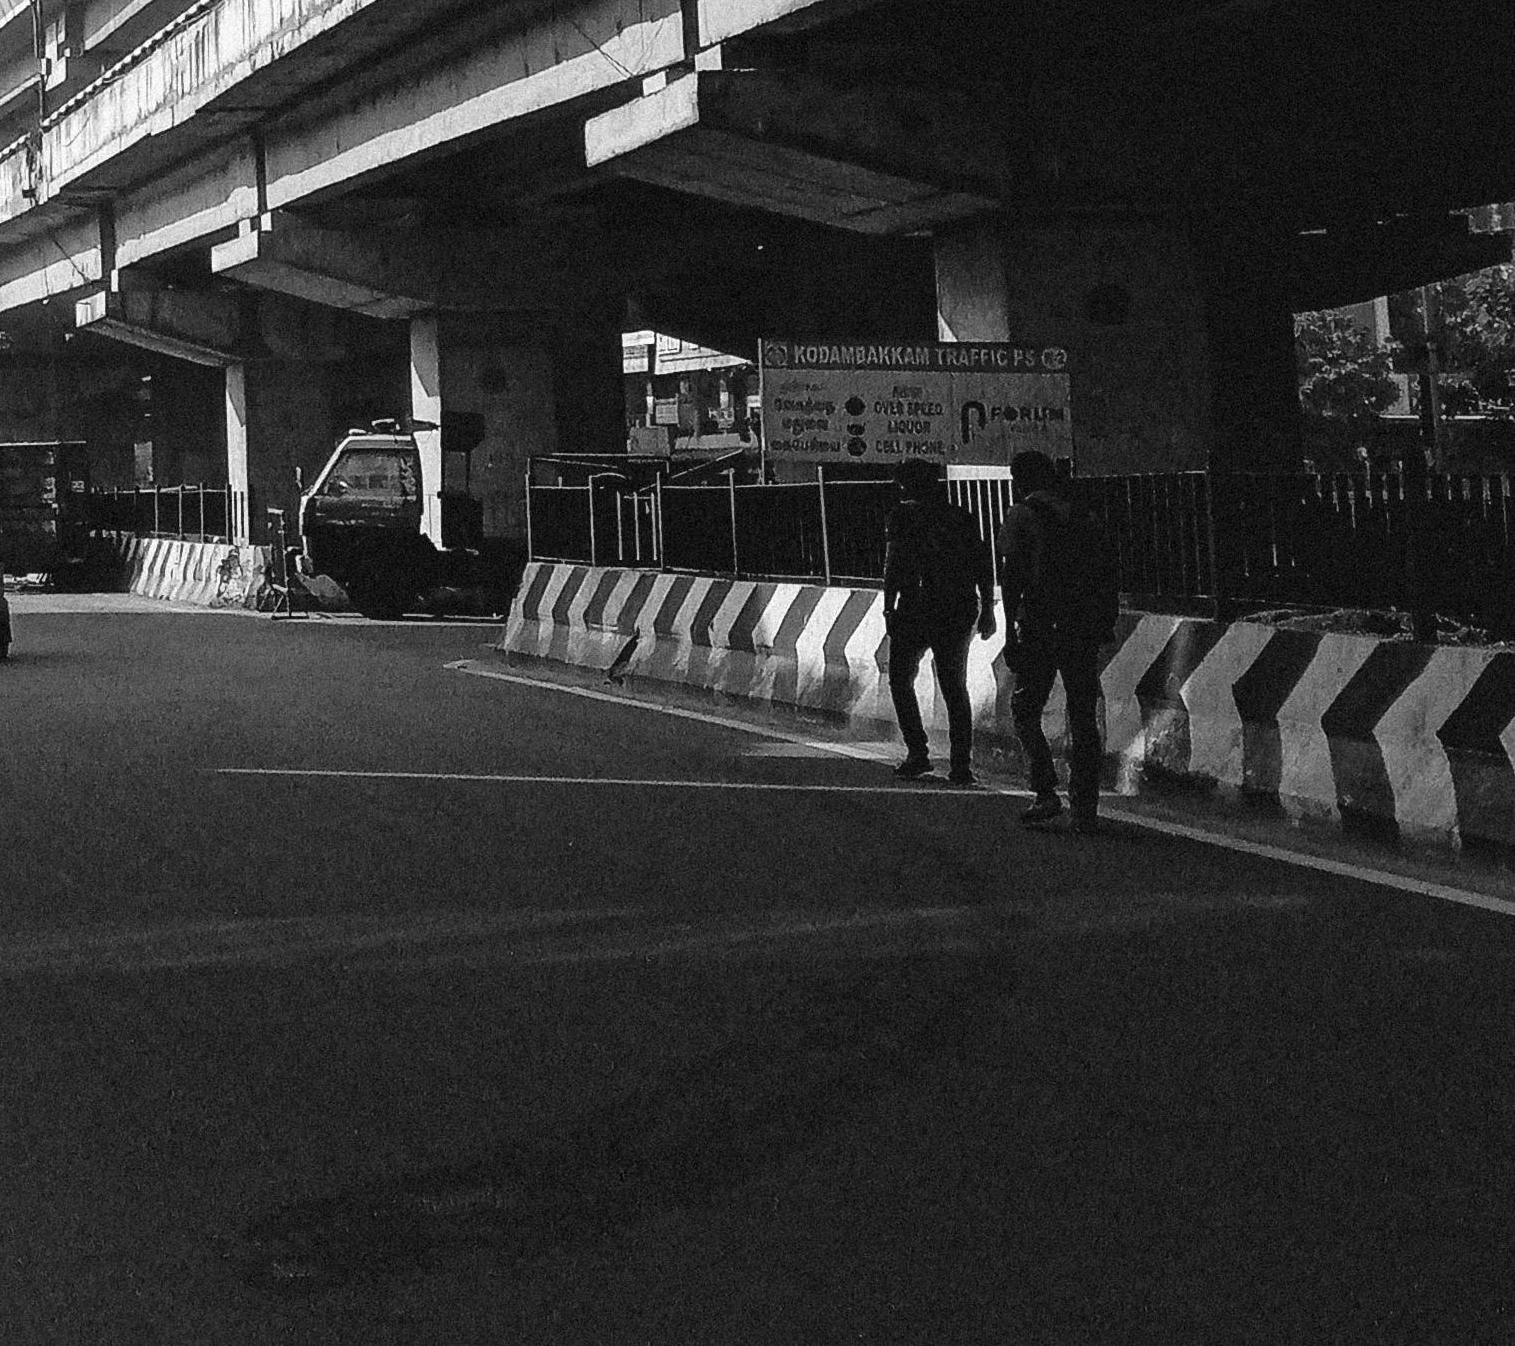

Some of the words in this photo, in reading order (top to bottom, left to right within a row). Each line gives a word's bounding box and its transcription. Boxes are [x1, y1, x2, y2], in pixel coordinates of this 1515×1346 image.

[794, 344, 930, 366] KODAMBAKKAM
[935, 347, 1008, 367] TRAFFIC
[1014, 349, 1035, 367] PS
[888, 419, 932, 434] LIQUOR
[875, 439, 903, 454] CELL
[906, 440, 946, 456] PHONE
